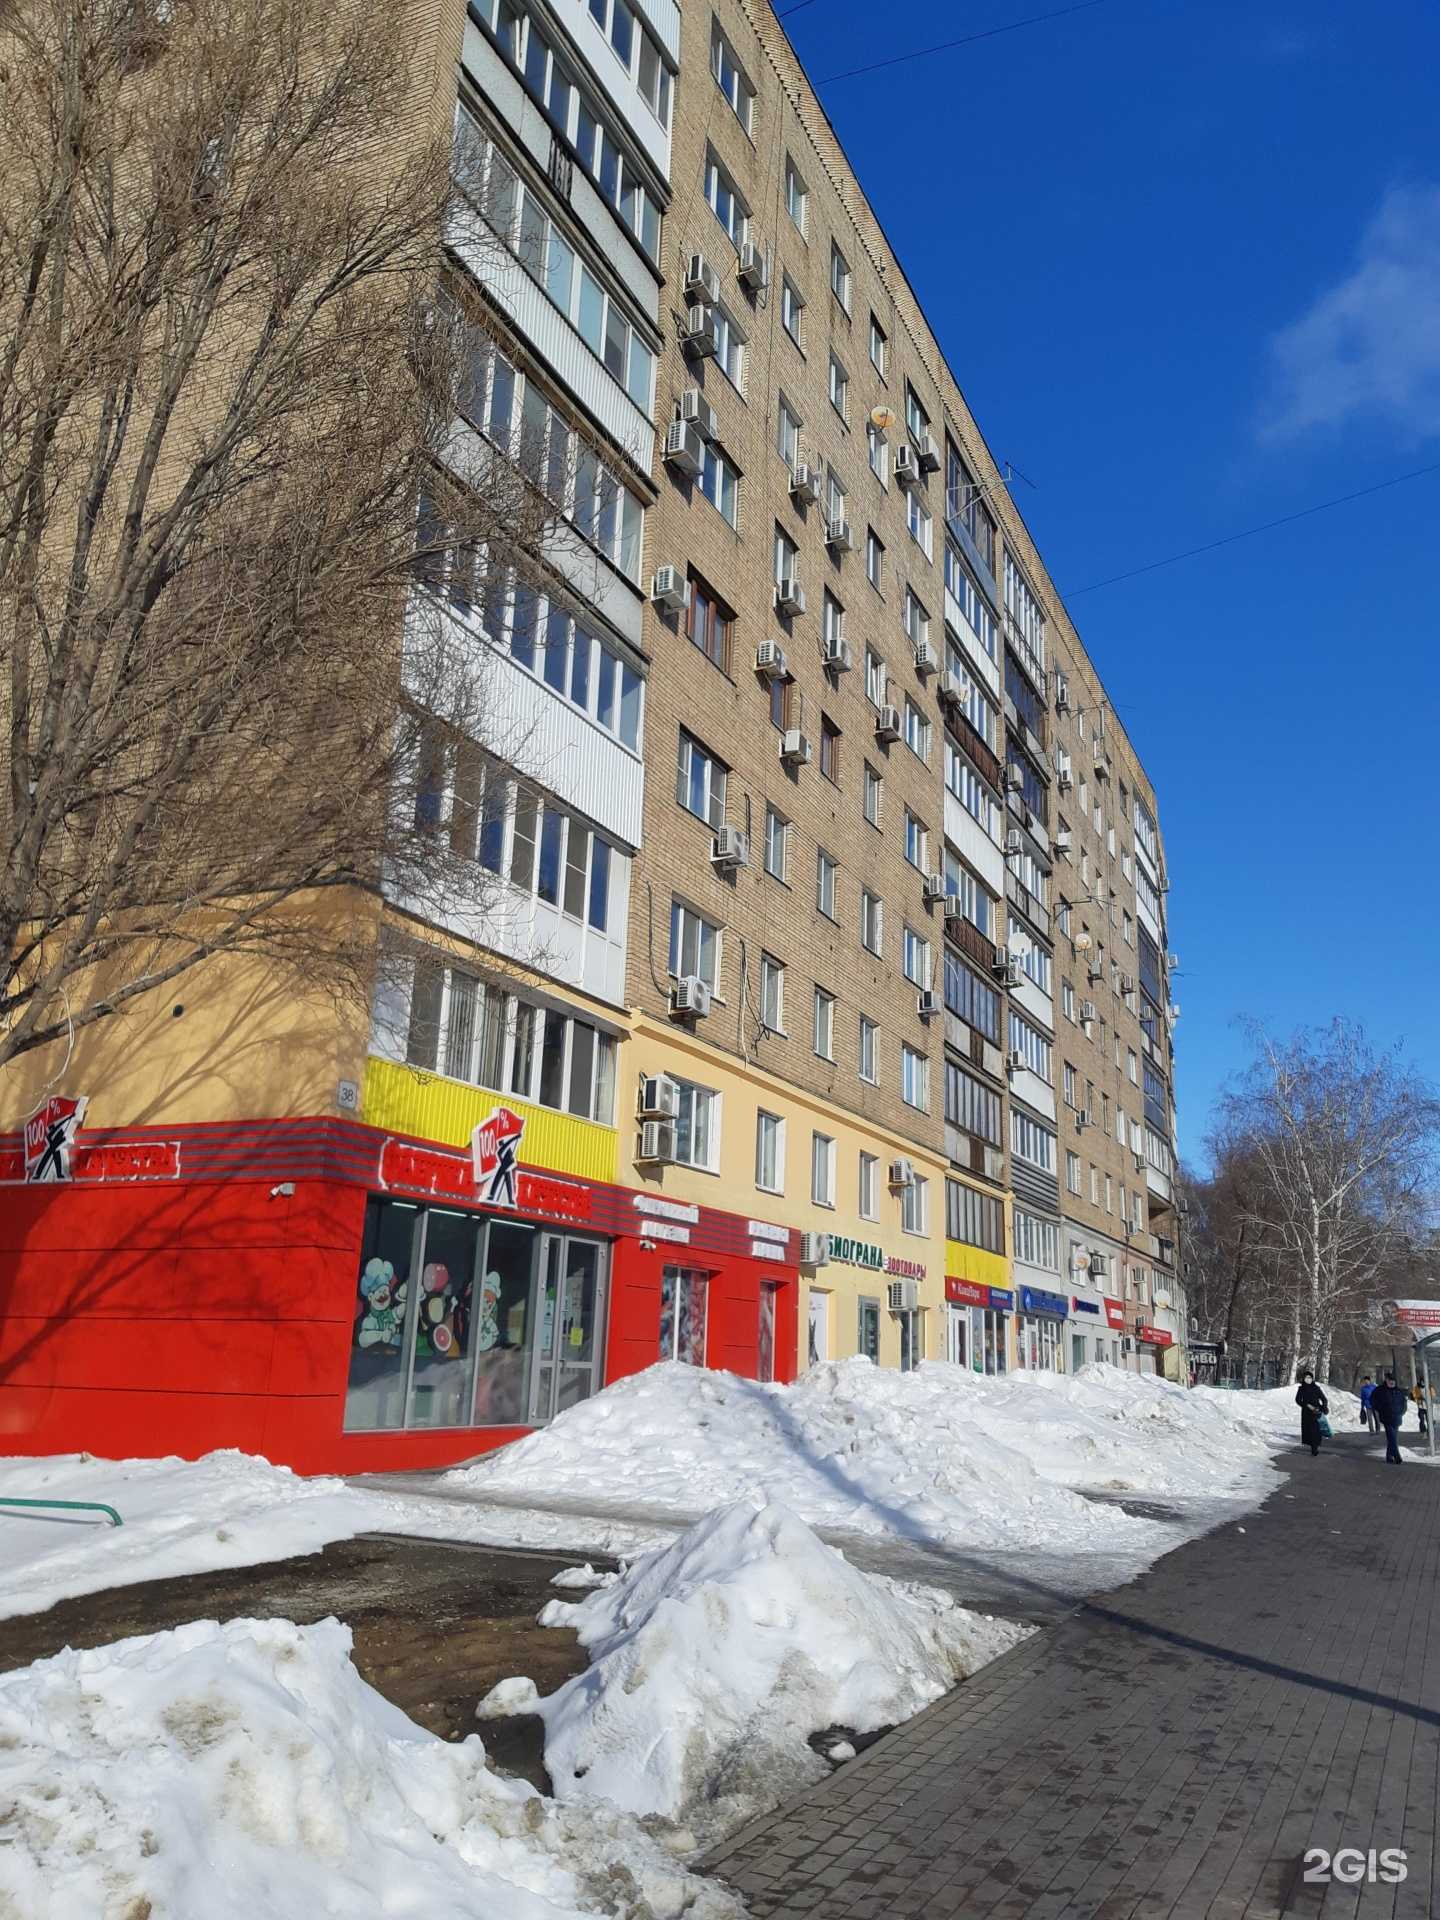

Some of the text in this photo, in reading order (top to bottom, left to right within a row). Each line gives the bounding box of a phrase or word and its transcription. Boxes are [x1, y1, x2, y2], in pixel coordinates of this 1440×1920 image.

[342, 1087, 354, 1102] 38
[27, 1119, 44, 1147] 100
[480, 1128, 496, 1160] 100
